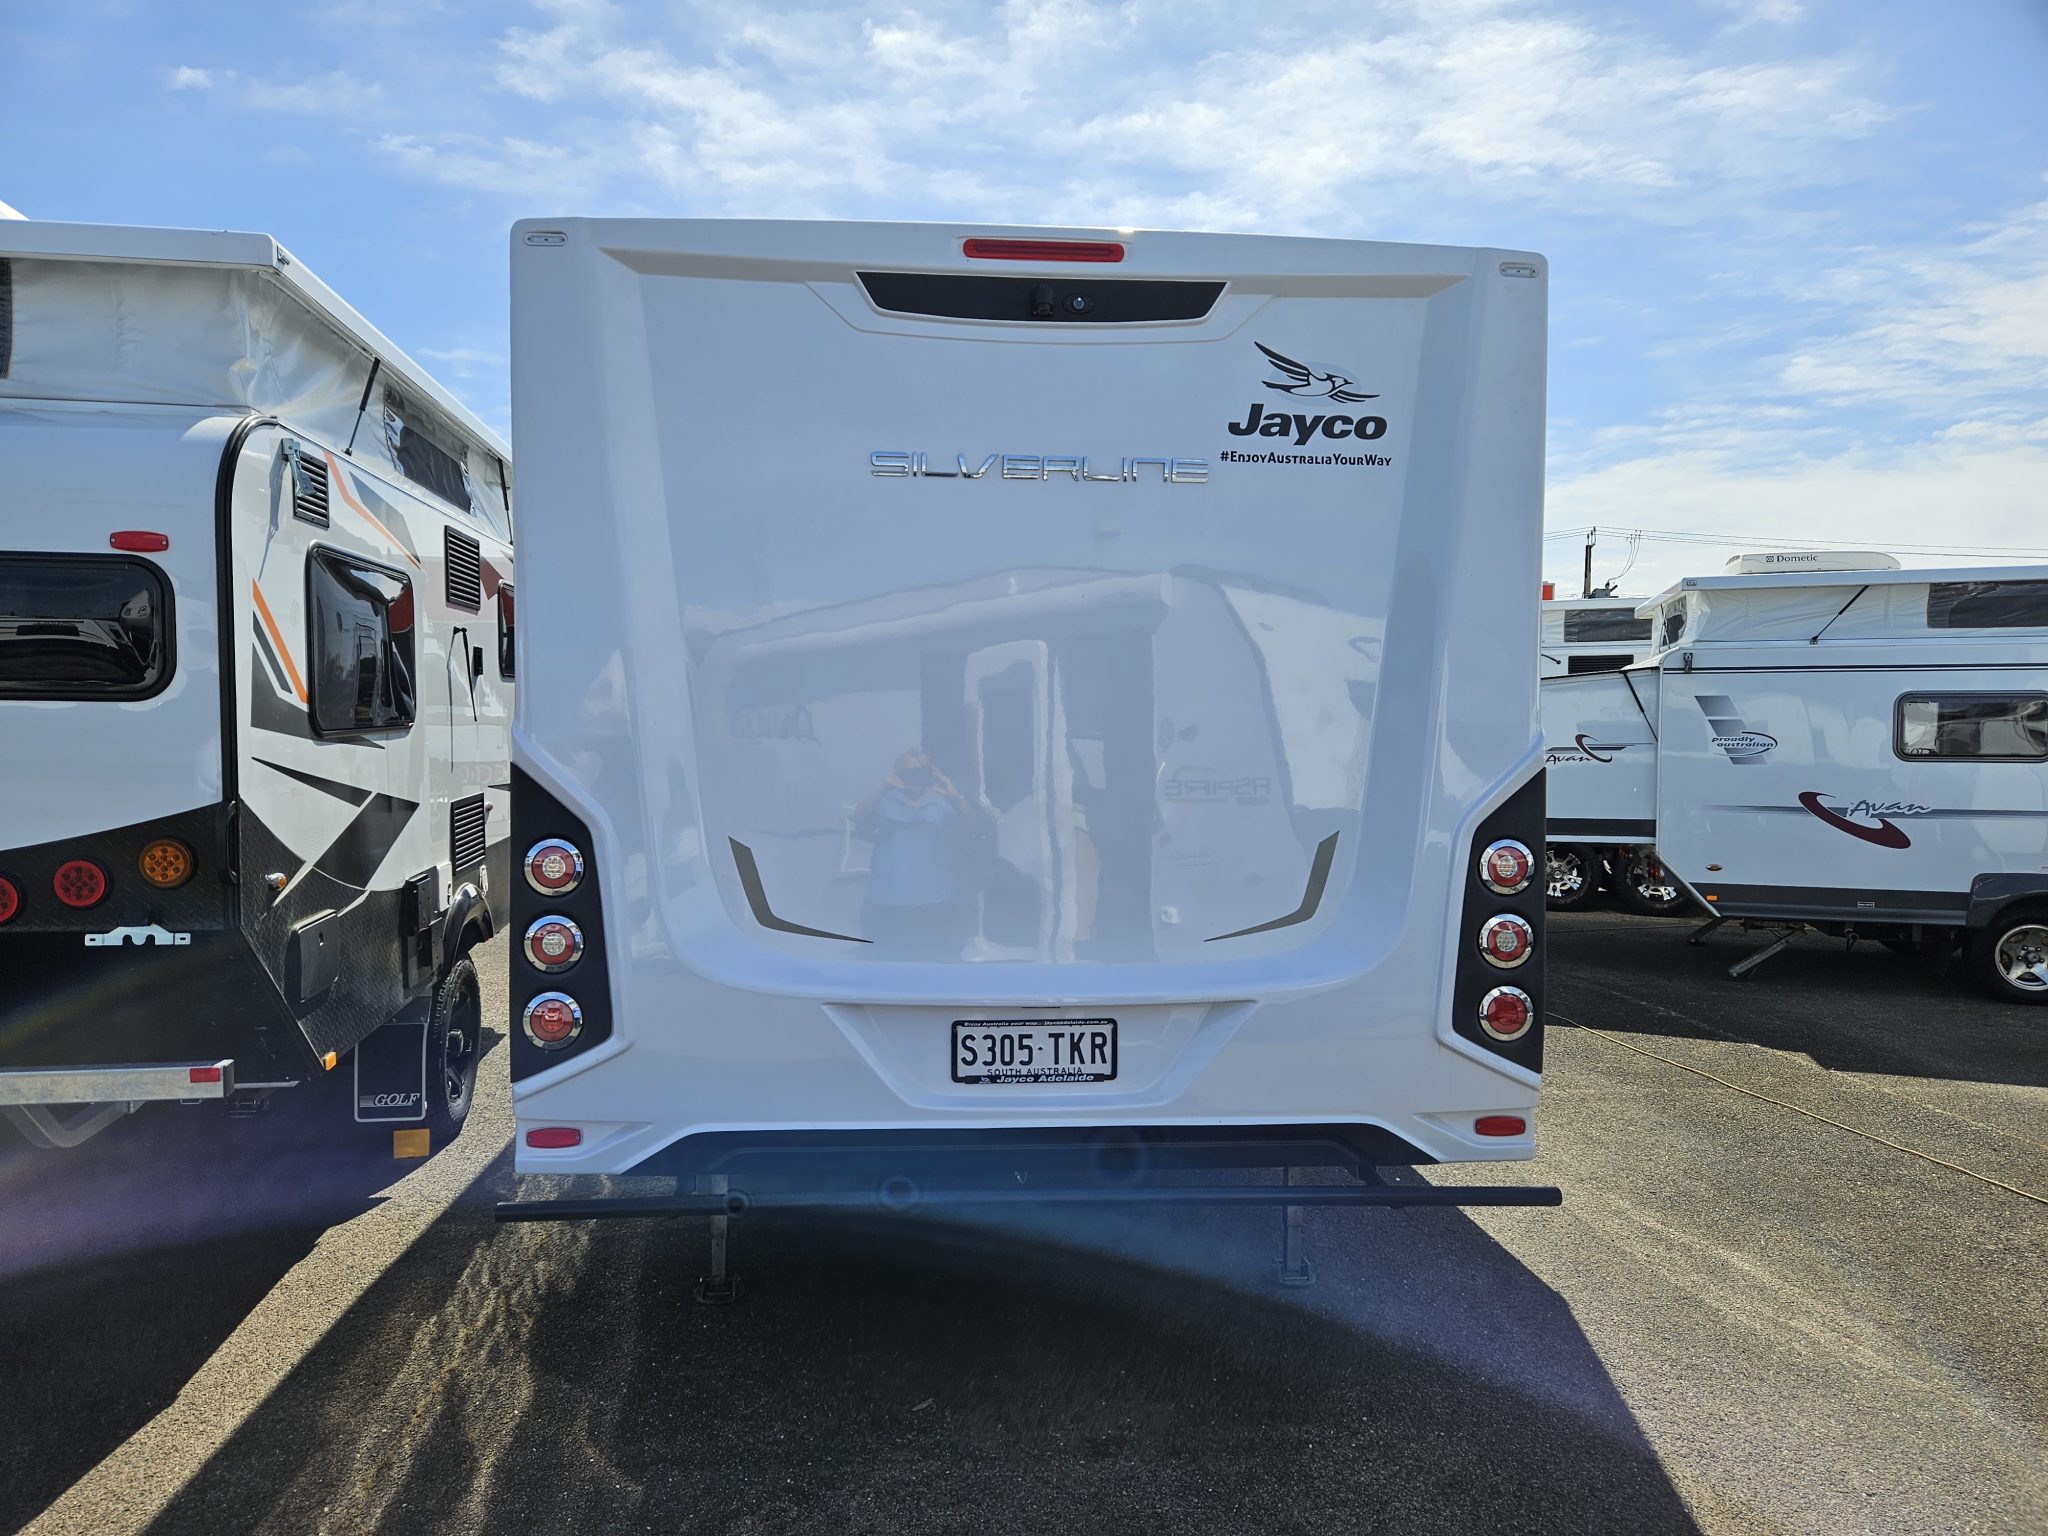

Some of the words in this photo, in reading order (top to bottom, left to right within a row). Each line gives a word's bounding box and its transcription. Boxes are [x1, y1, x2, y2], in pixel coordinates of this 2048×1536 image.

[1228, 403, 1388, 446] Jayco
[870, 450, 1209, 484] SILVERLINE
[1776, 553, 1819, 563] Dometic
[1544, 753, 1594, 766] Avan
[1848, 799, 1931, 817] Avan
[987, 1068, 1022, 1076] SOUTH
[1027, 1067, 1083, 1075] AUSTRALIA
[997, 1075, 1034, 1083] Jayco
[1038, 1074, 1095, 1083] Adelaide
[374, 1092, 420, 1106] GOLF
